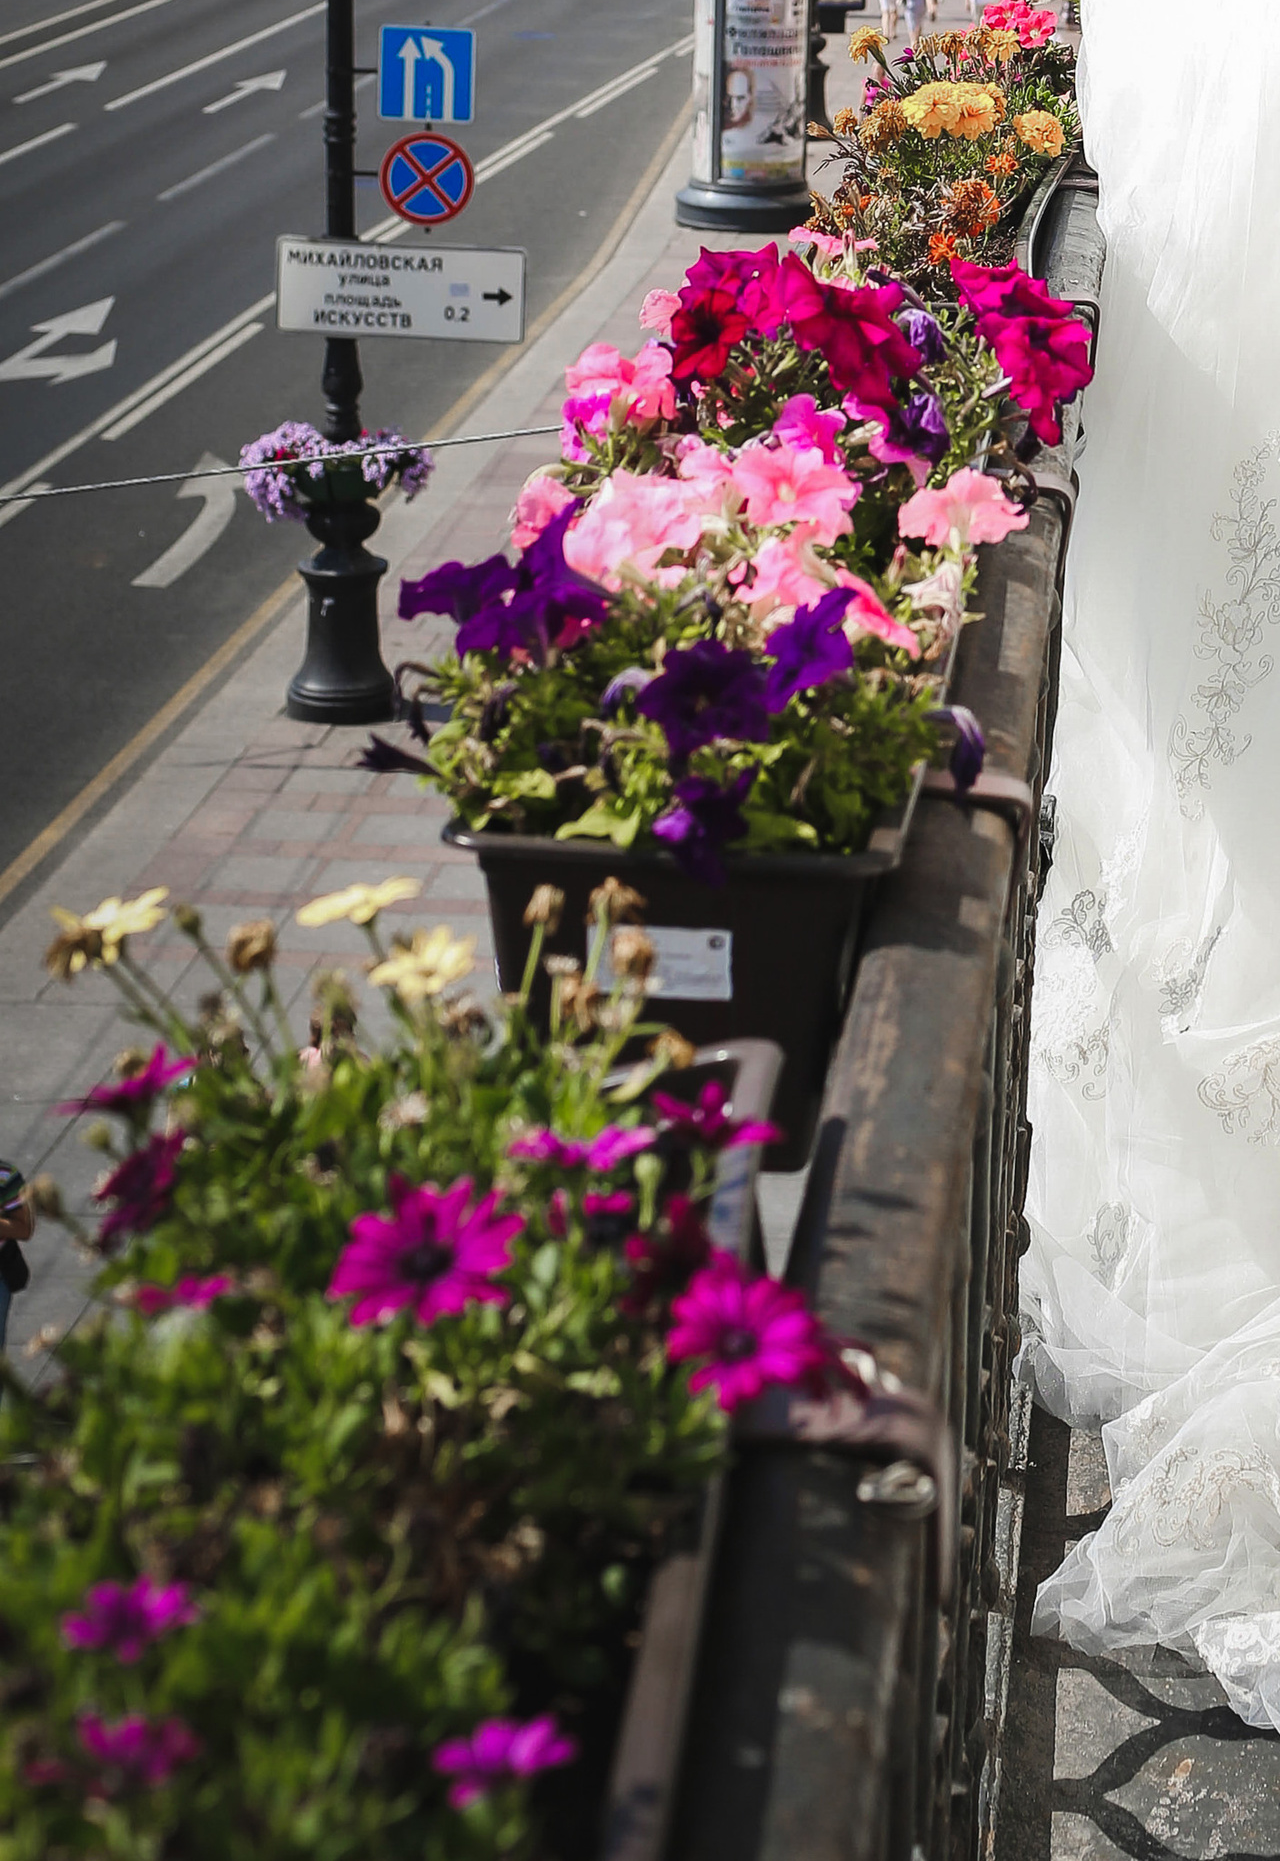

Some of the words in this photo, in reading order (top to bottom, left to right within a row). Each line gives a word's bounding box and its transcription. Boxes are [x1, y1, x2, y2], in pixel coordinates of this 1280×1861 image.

[287, 249, 443, 272] МИХАЙЛОВСКАЯ
[338, 274, 391, 288] улица
[324, 293, 402, 308] площадь
[314, 309, 412, 329] ИСКУССТВ
